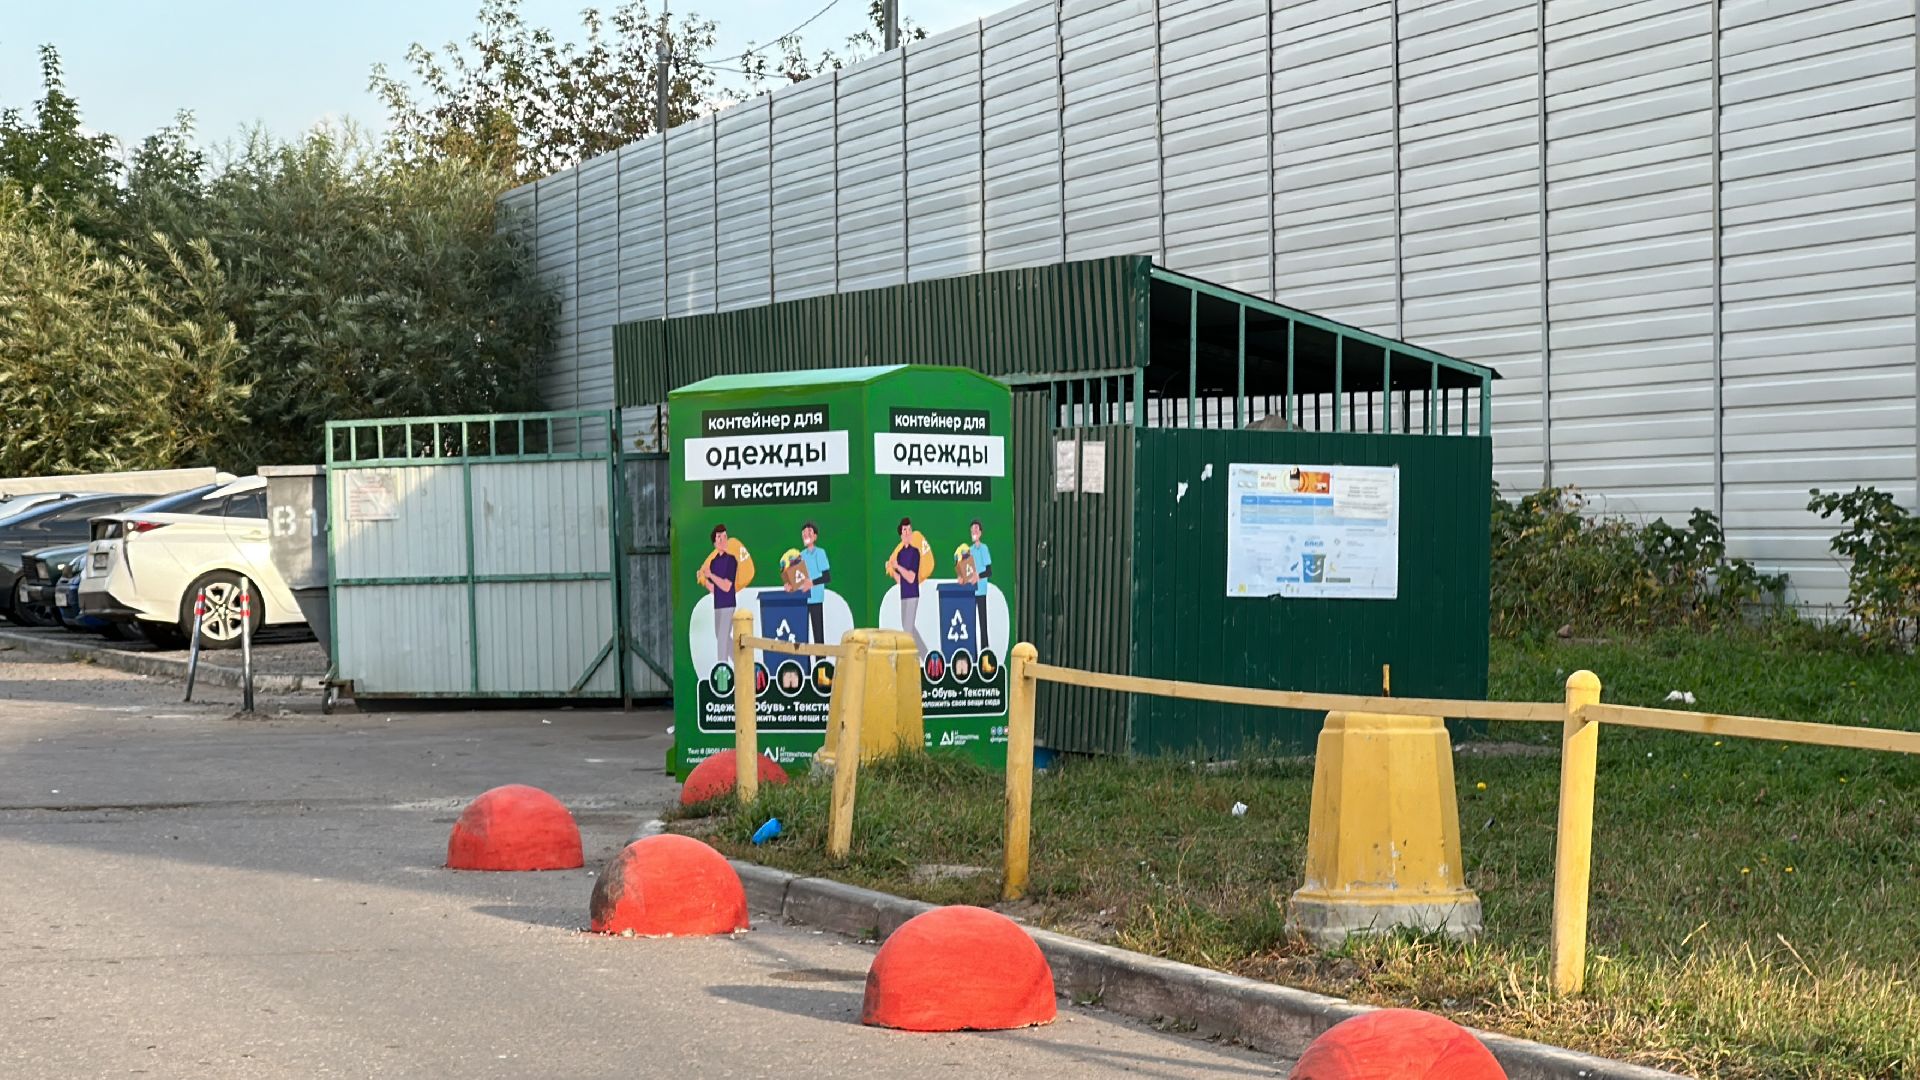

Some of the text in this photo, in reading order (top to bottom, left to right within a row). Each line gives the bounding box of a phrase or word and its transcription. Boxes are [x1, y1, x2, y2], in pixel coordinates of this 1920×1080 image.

[708, 411, 823, 431] контейнер для
[894, 412, 986, 431] контейнер для
[705, 441, 827, 470] одежды
[893, 443, 988, 467] одежды
[714, 480, 818, 500] и текстиля
[900, 479, 982, 495] и текстиля
[931, 686, 958, 700] Обувь
[963, 686, 1001, 698] Текстиль
[705, 702, 735, 714] Одеж
[793, 701, 829, 712] Тексти
[777, 714, 797, 722] свои
